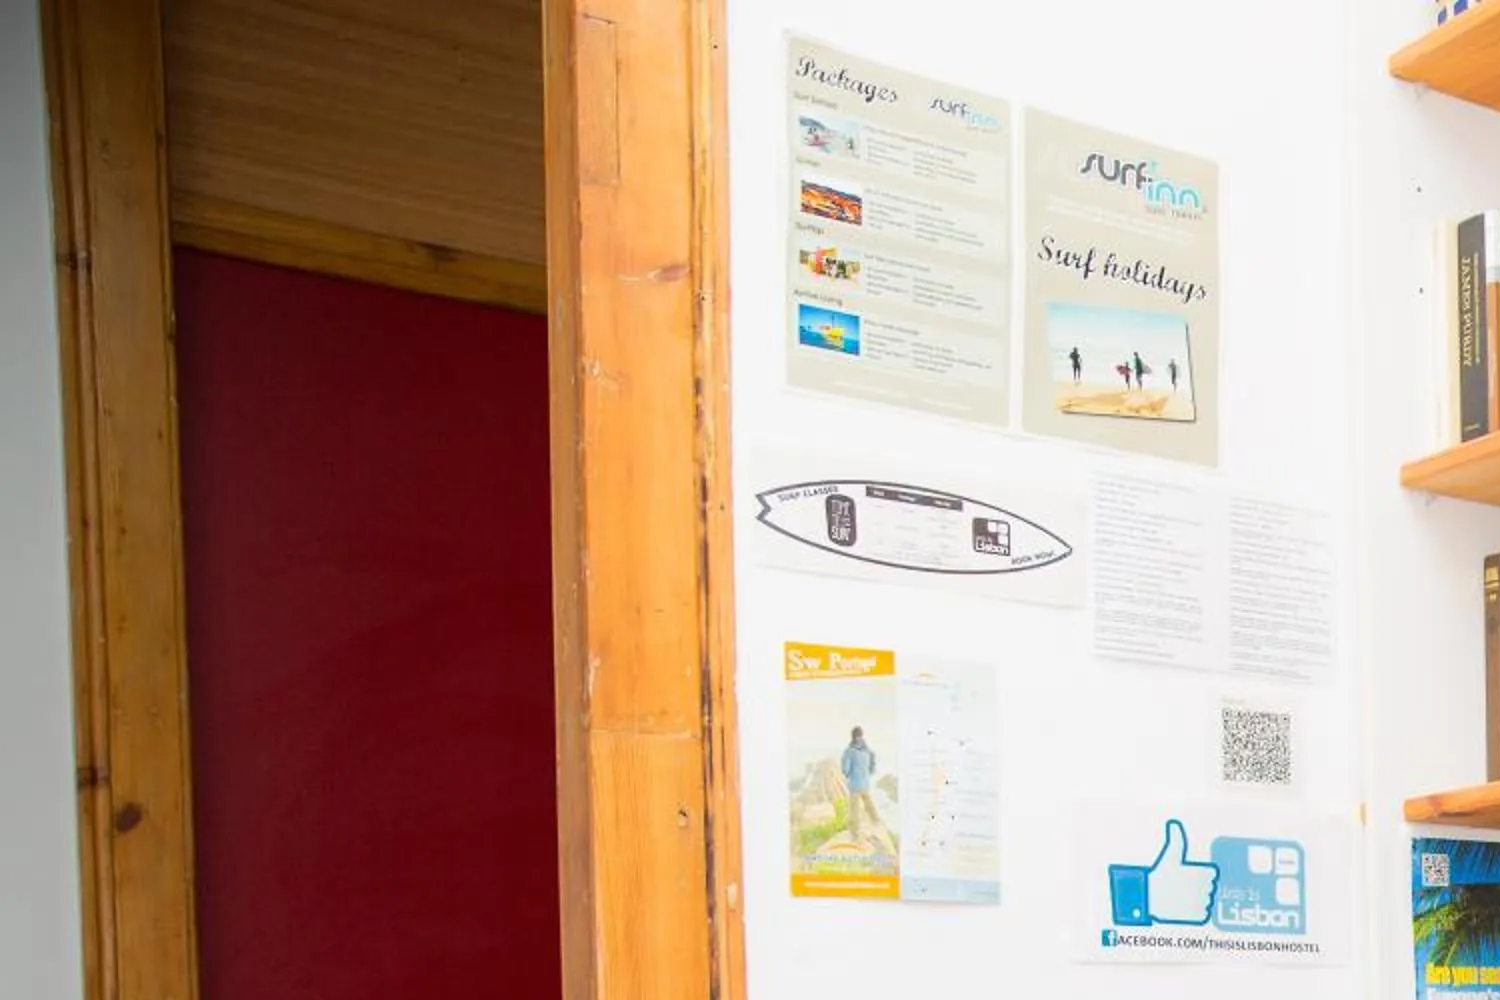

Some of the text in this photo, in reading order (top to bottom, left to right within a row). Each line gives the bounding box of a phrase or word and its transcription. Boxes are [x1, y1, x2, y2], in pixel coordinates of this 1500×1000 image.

[796, 56, 898, 102] Packages
[1037, 235, 1207, 304] Surf holidays
[1217, 901, 1301, 929] Lisbon
[1450, 966, 1478, 987] you
